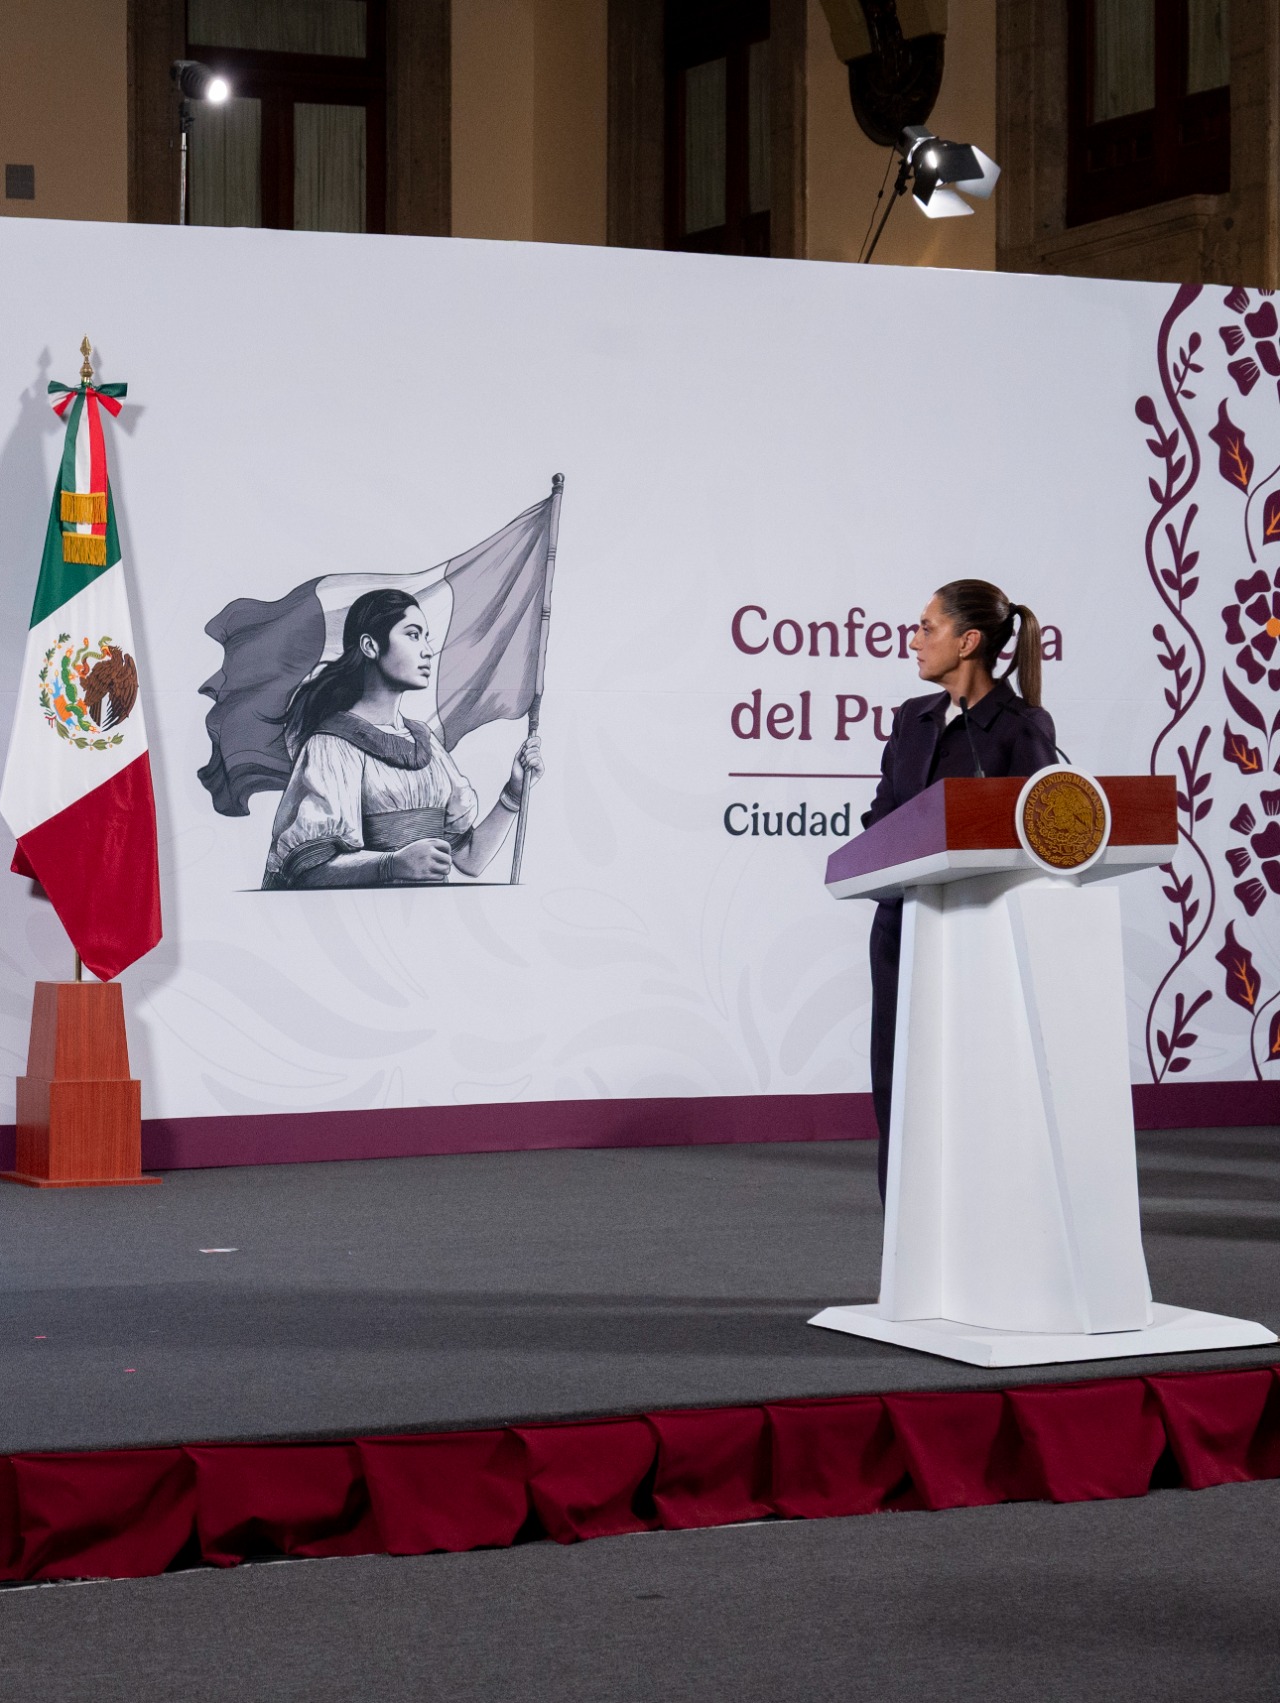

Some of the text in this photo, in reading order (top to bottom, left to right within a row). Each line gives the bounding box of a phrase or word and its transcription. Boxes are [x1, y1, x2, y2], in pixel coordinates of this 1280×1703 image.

[731, 604, 1063, 662] Confera
[730, 688, 812, 740] del
[723, 802, 851, 836] Ciudad
[1025, 780, 1045, 820] ESTADOS
[1044, 774, 1072, 786] UNIDOS
